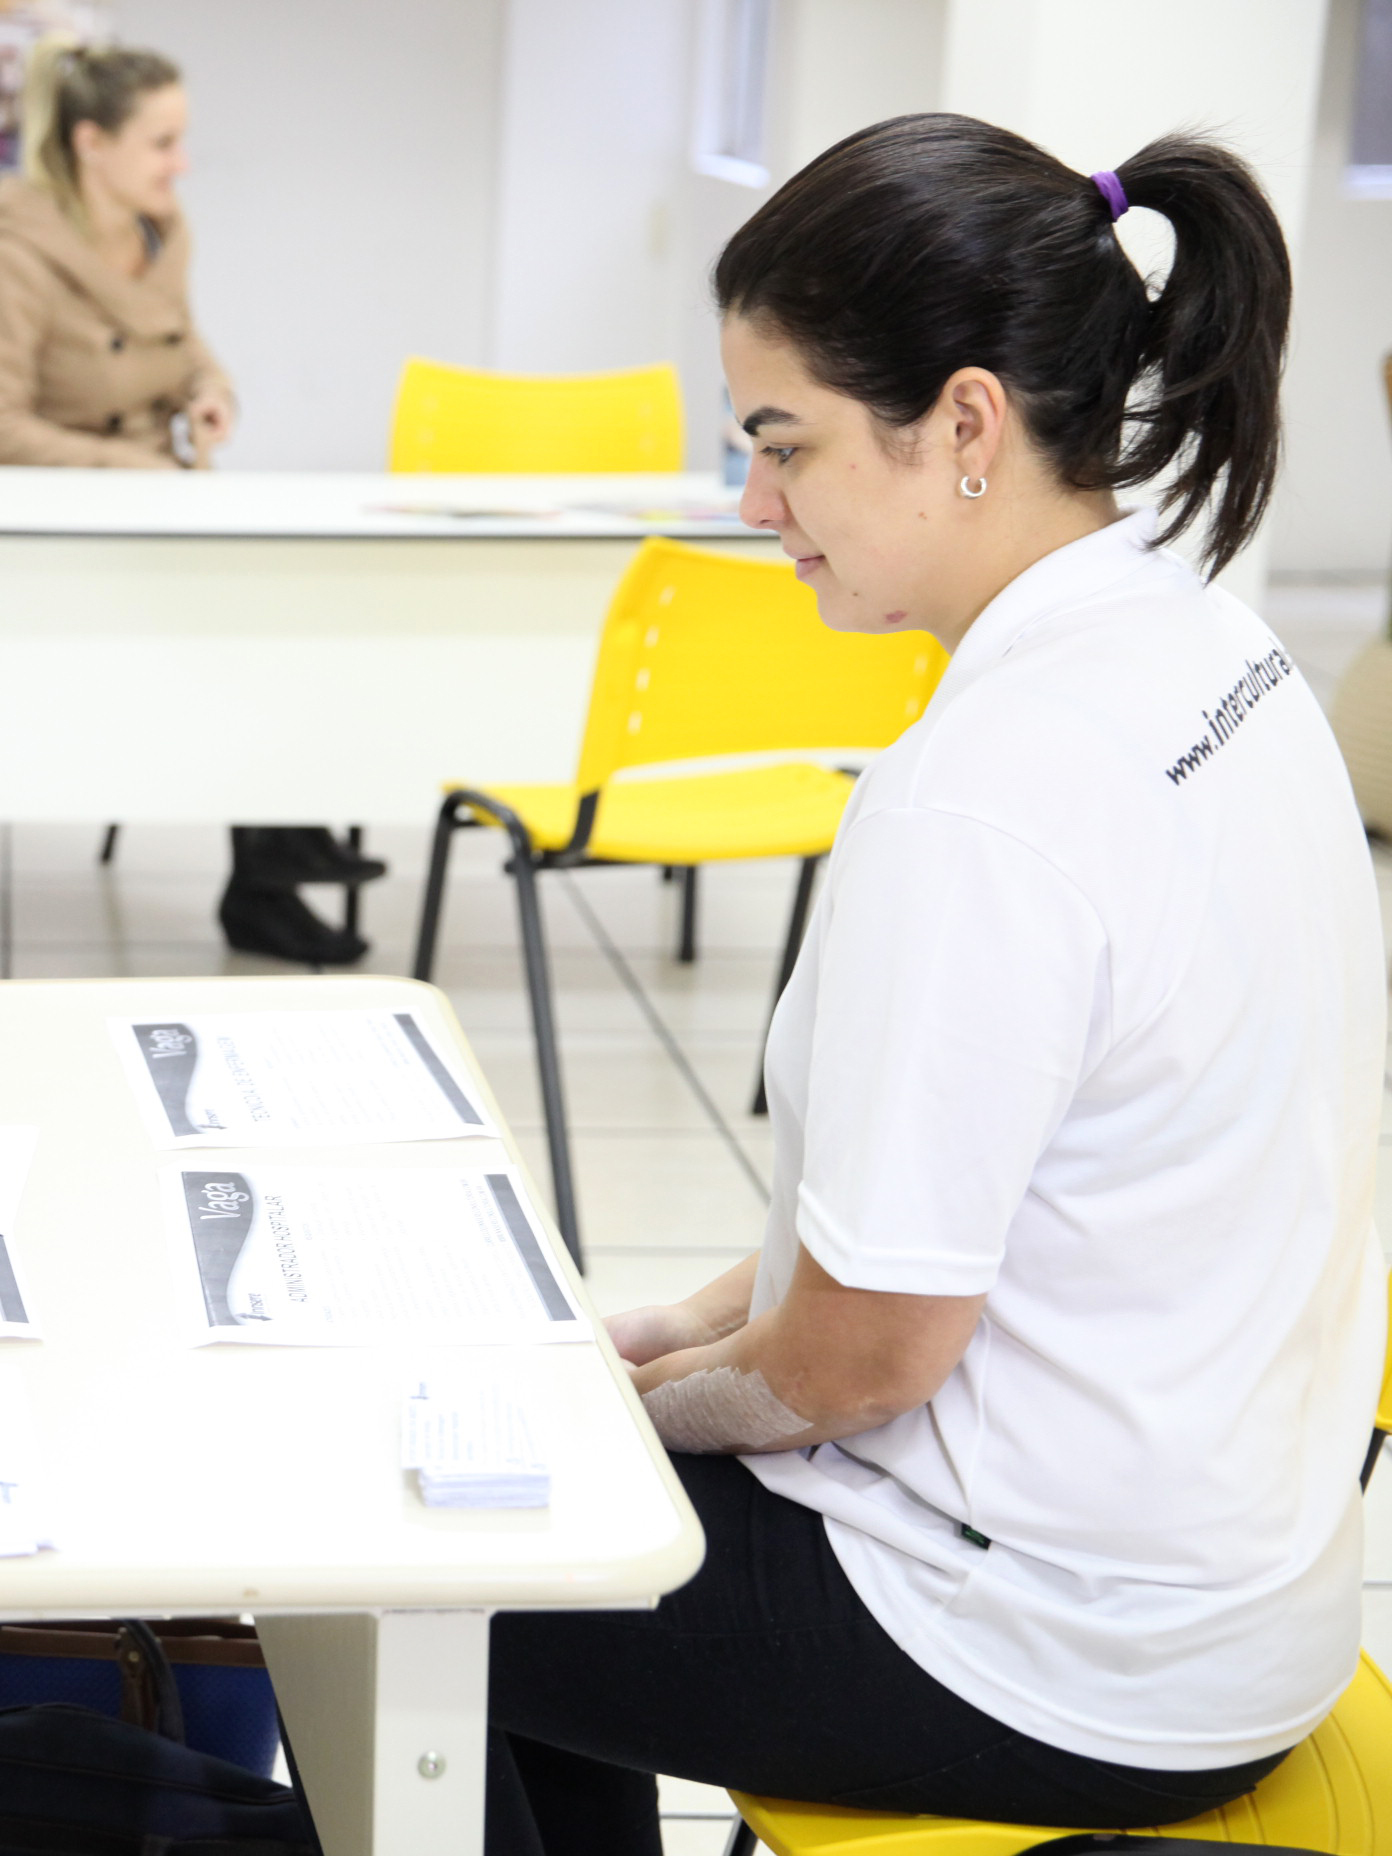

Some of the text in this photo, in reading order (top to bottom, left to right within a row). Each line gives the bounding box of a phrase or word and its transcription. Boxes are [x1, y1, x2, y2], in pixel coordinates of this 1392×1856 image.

[149, 1028, 192, 1059] Vaga
[199, 1181, 250, 1220] Vaga
[264, 1194, 310, 1304] ADMINISTRADOR HOSPITALAR
